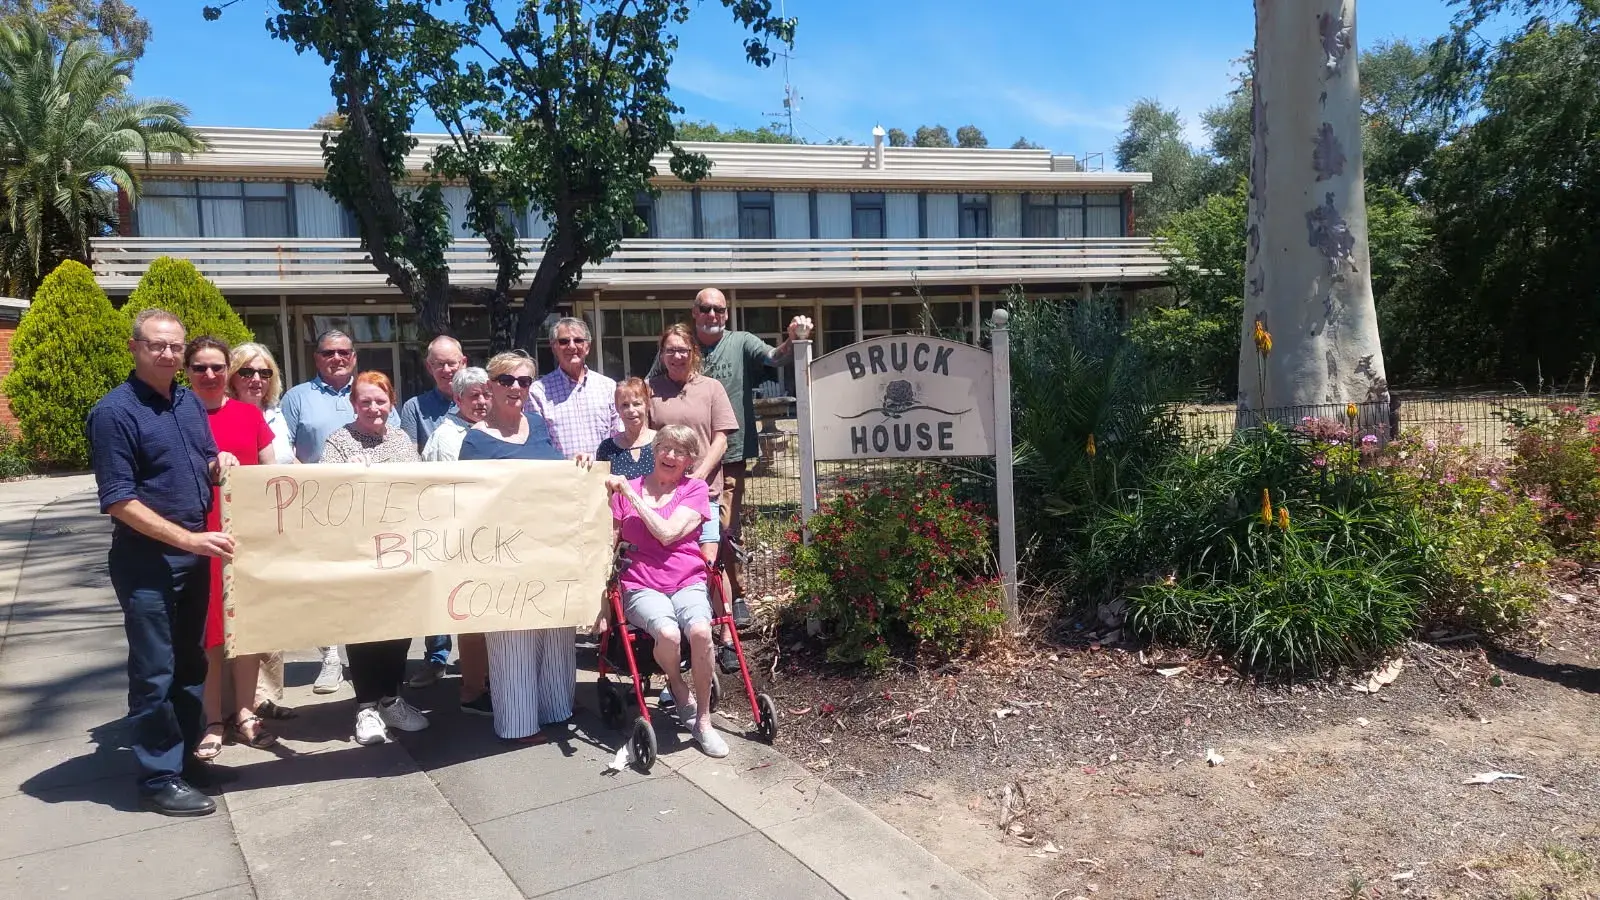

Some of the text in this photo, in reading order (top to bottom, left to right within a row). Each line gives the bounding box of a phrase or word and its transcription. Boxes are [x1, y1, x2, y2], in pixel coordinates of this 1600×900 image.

[845, 342, 954, 380] BRUCK
[851, 422, 954, 455] HOUSE
[265, 475, 477, 535] PROTECT
[374, 528, 524, 570] BRUCK
[447, 578, 579, 621] COURT
